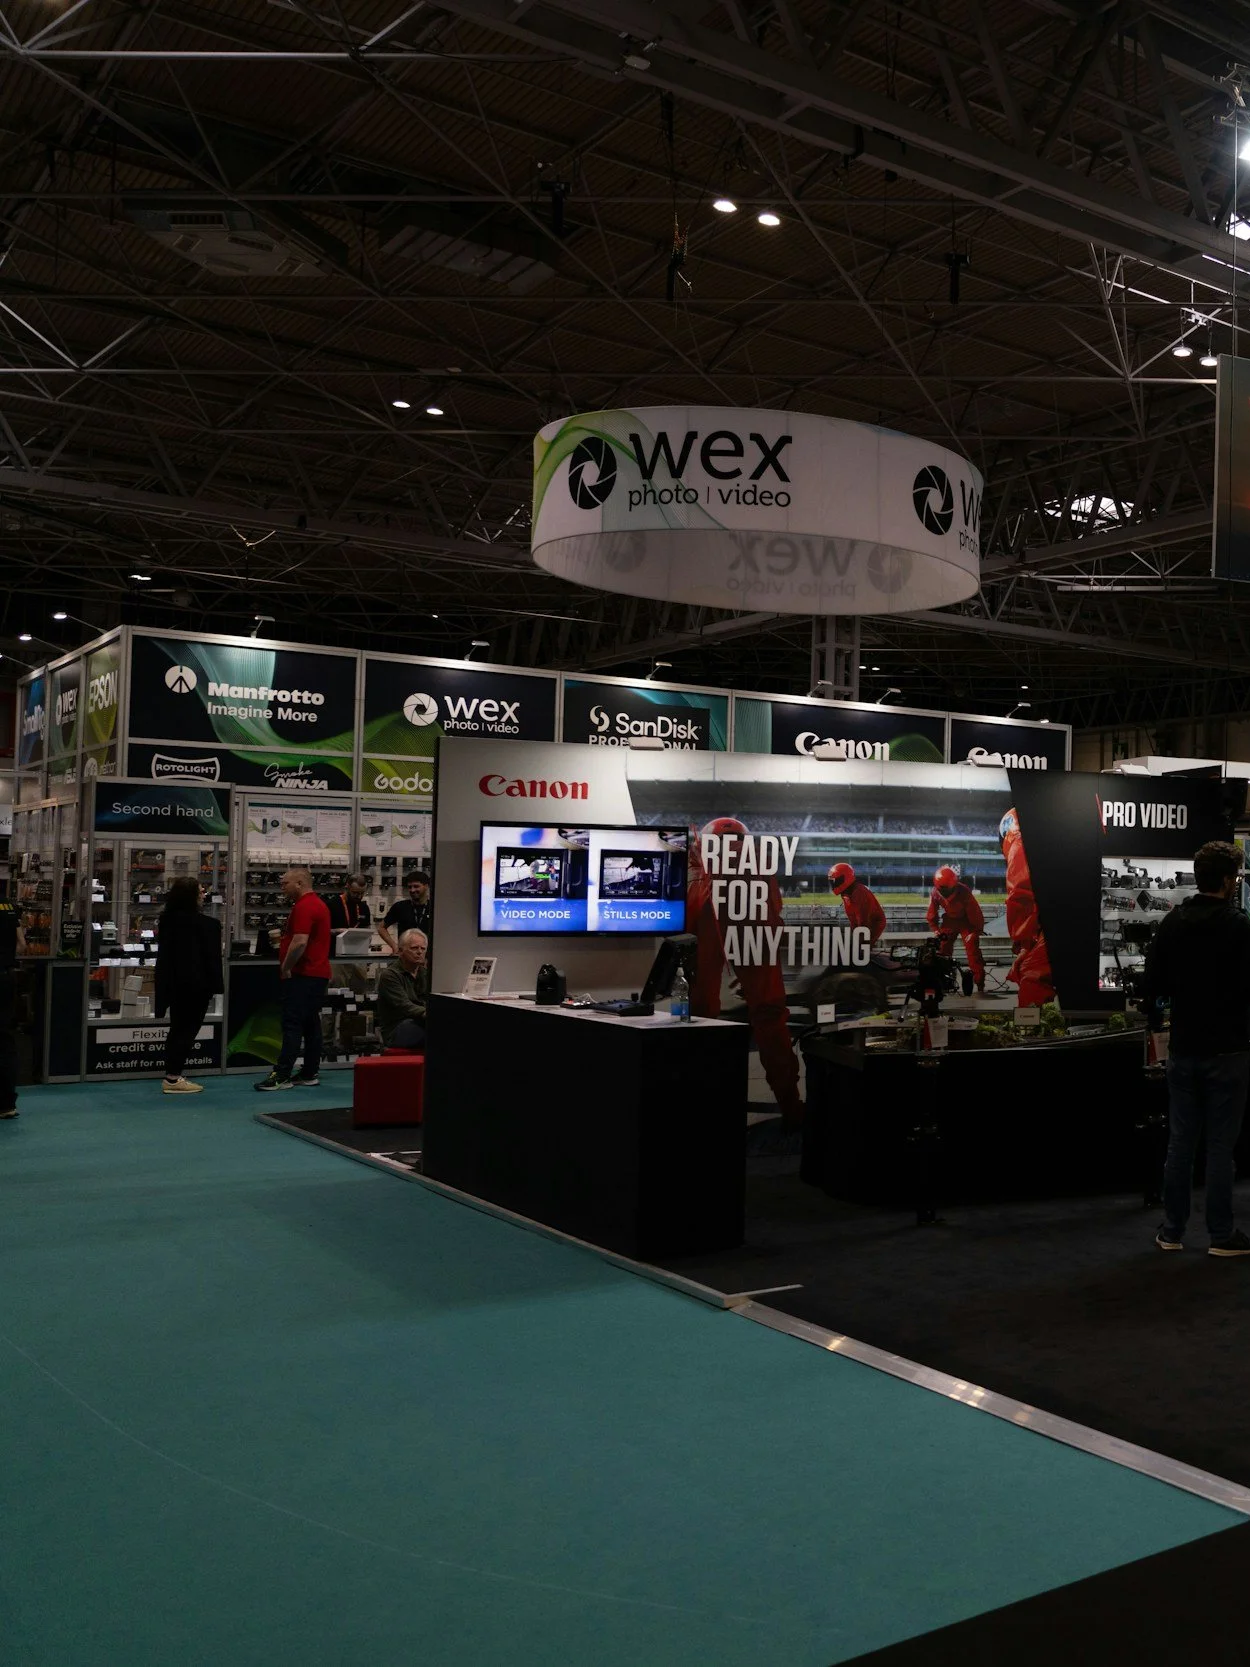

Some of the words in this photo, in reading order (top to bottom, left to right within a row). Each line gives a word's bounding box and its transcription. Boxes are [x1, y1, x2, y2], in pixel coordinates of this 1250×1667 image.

[629, 430, 793, 483] wex
[628, 483, 699, 512] photo
[717, 483, 791, 508] video
[88, 670, 118, 714] EPSON
[207, 681, 325, 706] Manfrotto
[207, 701, 273, 720] Imagine
[277, 706, 318, 723] More
[443, 695, 520, 724] wex
[443, 718, 479, 732] photo
[486, 721, 520, 735] video
[615, 712, 699, 740] SanDisk
[155, 763, 217, 775] ROTOLIGHT
[264, 762, 313, 782] Smoke
[275, 778, 329, 790] NINJA
[374, 772, 434, 792] Godo
[478, 774, 589, 800] Canon
[112, 802, 171, 816] Second
[176, 805, 214, 818] hand
[1102, 800, 1136, 829] PRO
[1140, 802, 1189, 830] VIDEO
[701, 833, 800, 877] READY
[712, 879, 769, 921] FOR
[501, 910, 536, 919] VIDEO
[538, 910, 571, 919] MODE
[603, 910, 638, 920] STILLS
[640, 910, 672, 920] MODE
[723, 925, 872, 967] ANYTHING
[109, 1042, 144, 1053] credit
[95, 1061, 114, 1070] Ask
[116, 1059, 138, 1068] staff
[140, 1059, 154, 1068] for
